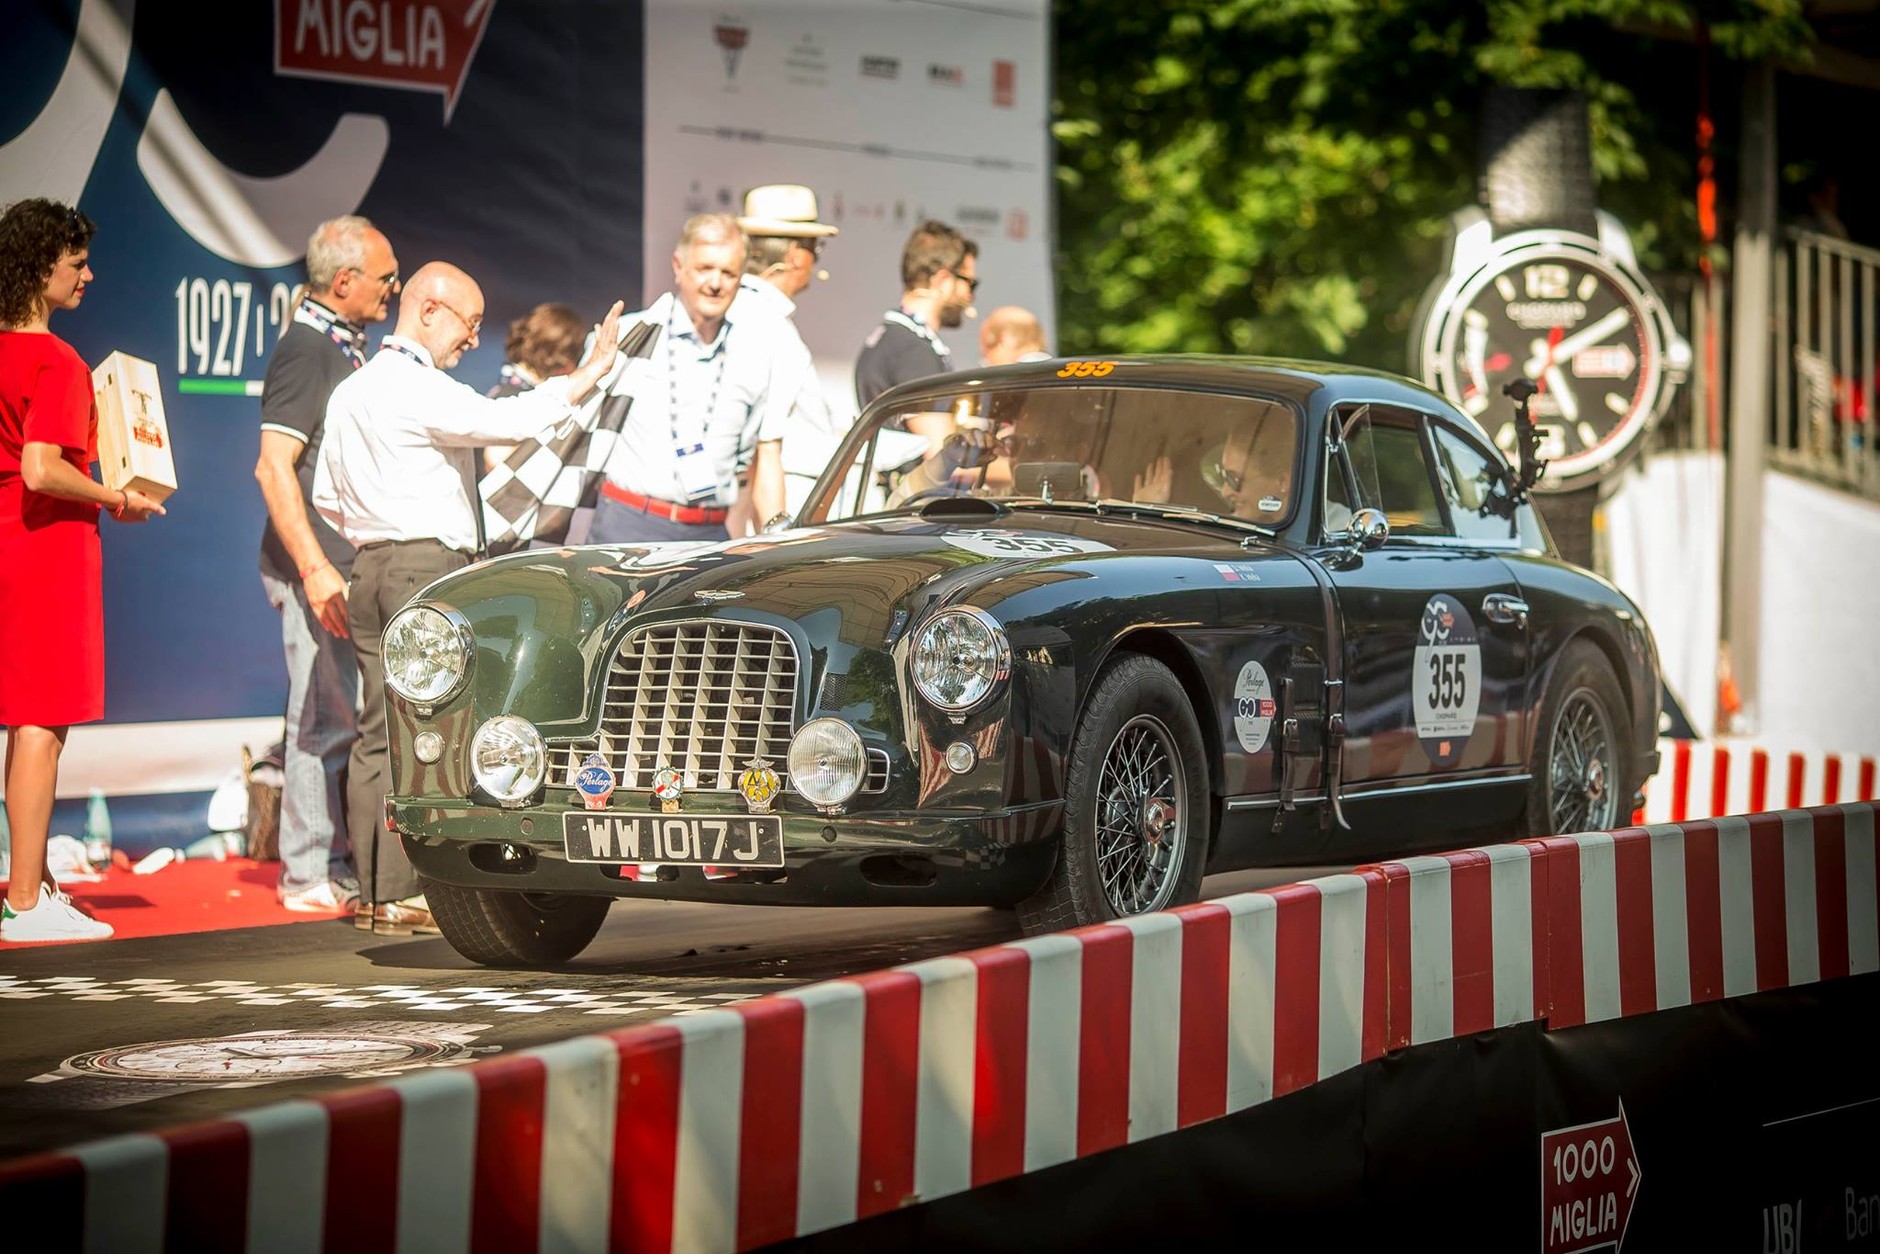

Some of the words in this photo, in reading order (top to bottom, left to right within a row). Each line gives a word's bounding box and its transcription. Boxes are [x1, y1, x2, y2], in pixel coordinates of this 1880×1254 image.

[294, 0, 446, 70] MIGLIA
[175, 276, 253, 377] 1927
[1056, 361, 1119, 378] 355
[982, 537, 1084, 553] 355
[1428, 653, 1466, 709] 355
[586, 818, 640, 858] WW
[1553, 1135, 1616, 1186] 1000
[1550, 1191, 1618, 1248] MIGLIA
